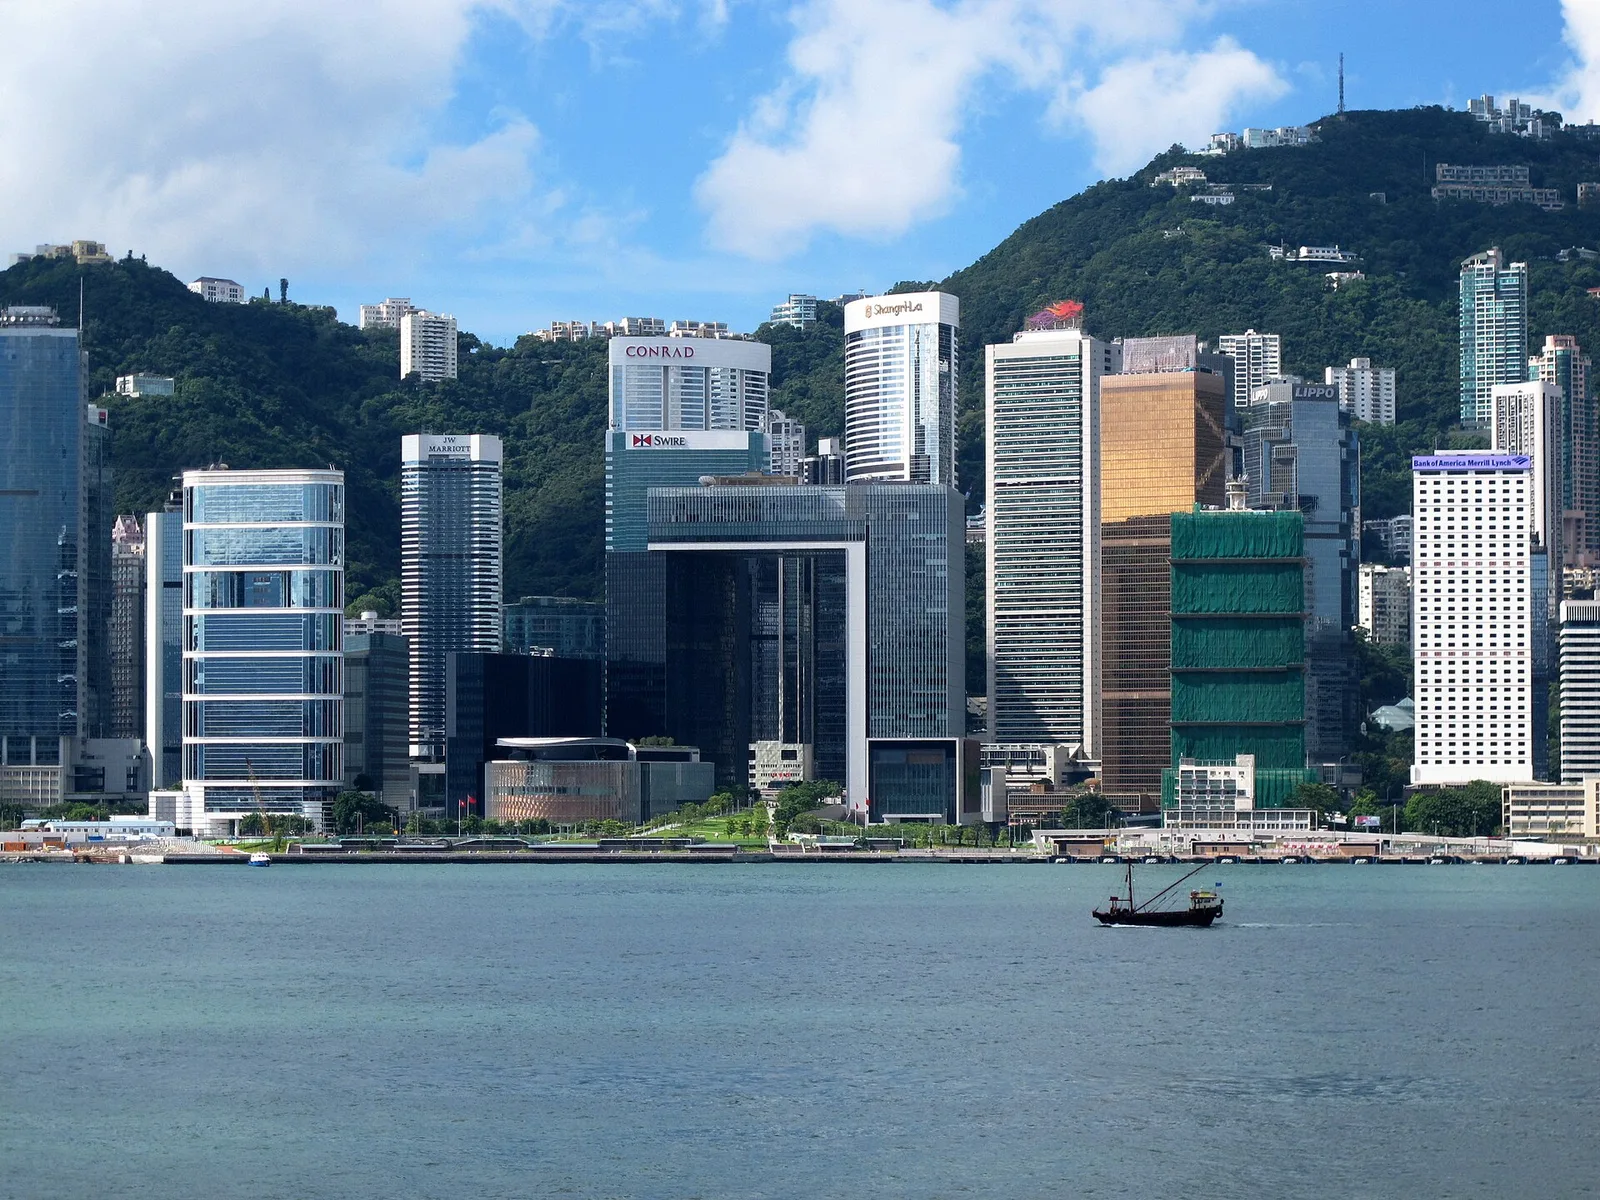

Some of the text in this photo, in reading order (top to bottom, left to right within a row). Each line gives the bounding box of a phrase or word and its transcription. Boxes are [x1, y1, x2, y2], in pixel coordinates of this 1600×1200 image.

[626, 346, 695, 358] CONRAD
[1252, 389, 1268, 401] LIPPO
[1295, 387, 1335, 398] LIPPO
[1491, 460, 1512, 468] Lynch
